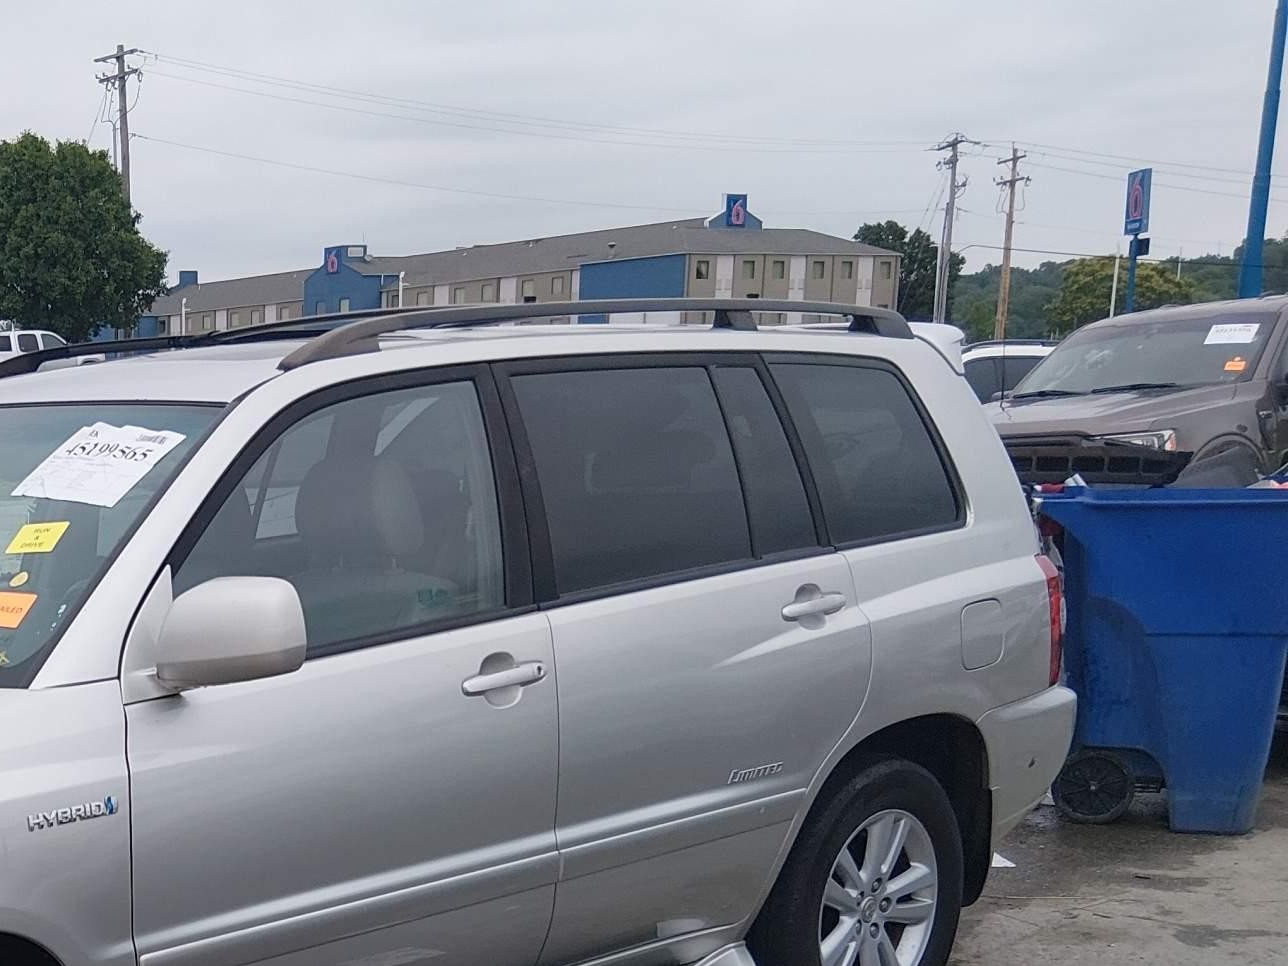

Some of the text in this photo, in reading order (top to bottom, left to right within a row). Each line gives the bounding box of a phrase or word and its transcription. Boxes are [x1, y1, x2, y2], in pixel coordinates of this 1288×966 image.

[732, 199, 745, 225] 6
[327, 249, 338, 273] 6
[27, 801, 105, 832] HYBRID
